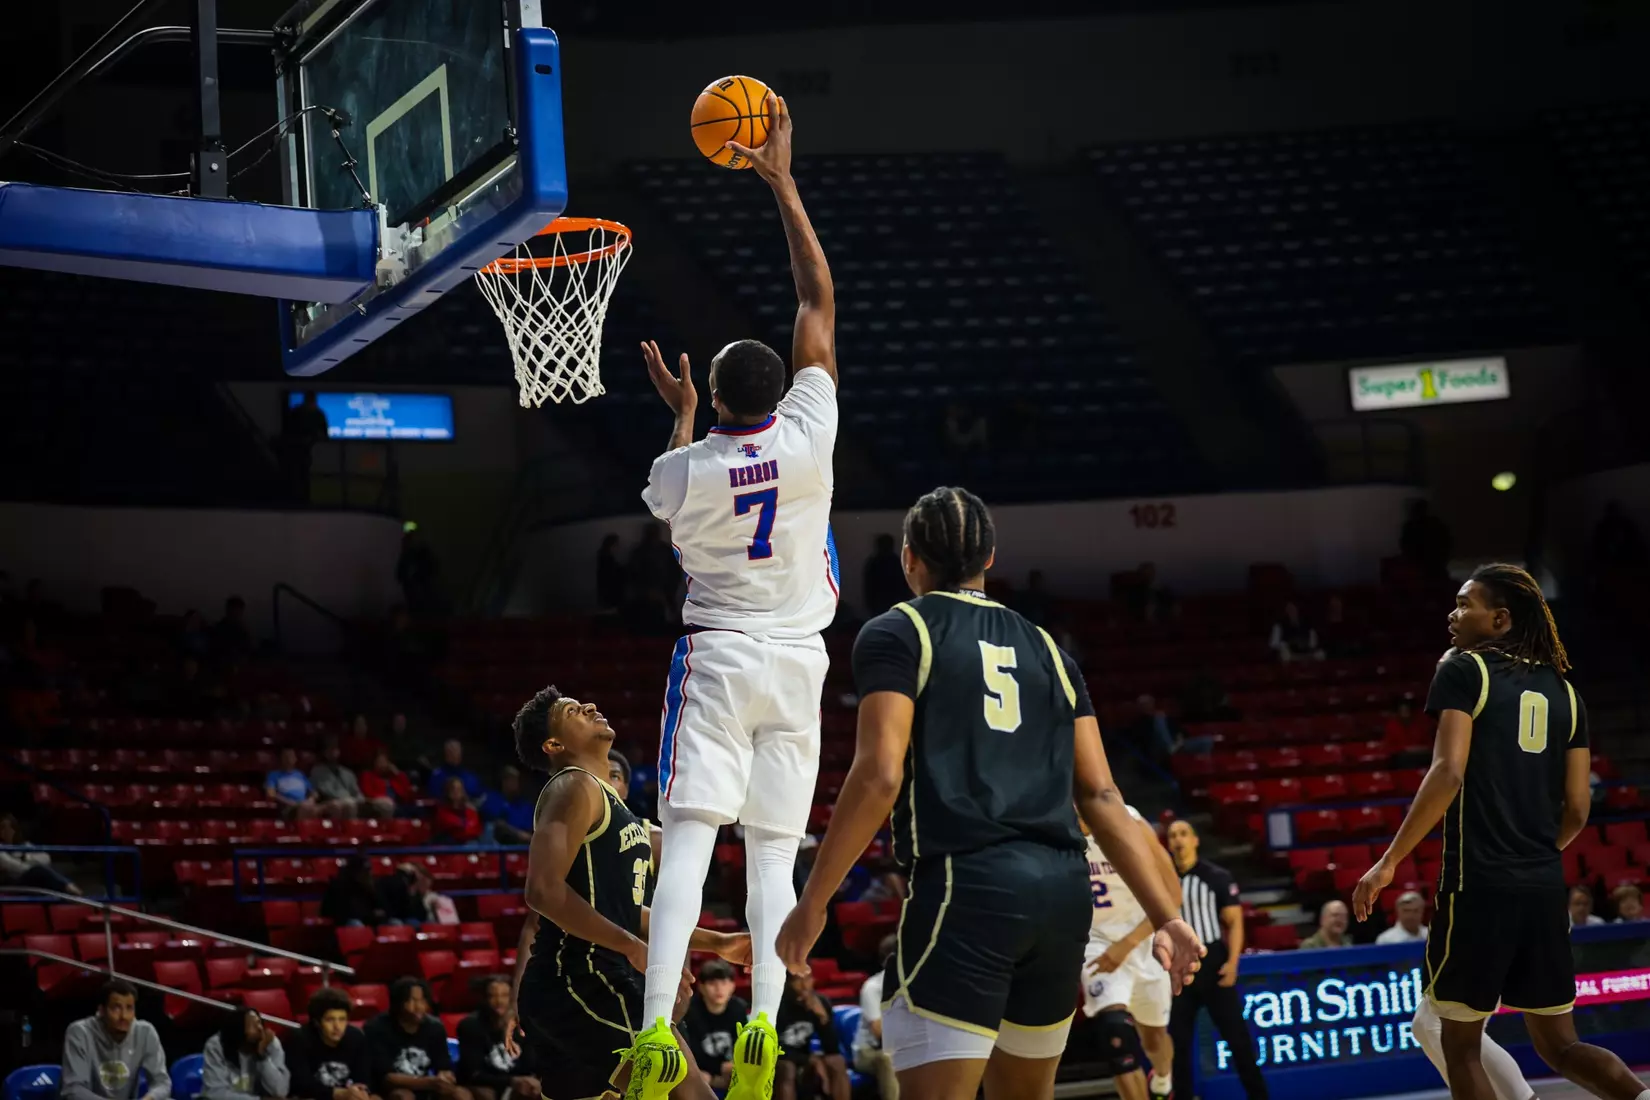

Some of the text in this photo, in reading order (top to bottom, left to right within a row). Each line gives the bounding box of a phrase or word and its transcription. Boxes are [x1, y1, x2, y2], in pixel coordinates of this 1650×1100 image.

[1358, 366, 1498, 400] Super 1 Foods
[729, 459, 779, 488] HERRON
[734, 487, 778, 560] 7
[1129, 503, 1176, 529] 102
[978, 640, 1022, 733] 5
[1518, 690, 1549, 753] 0
